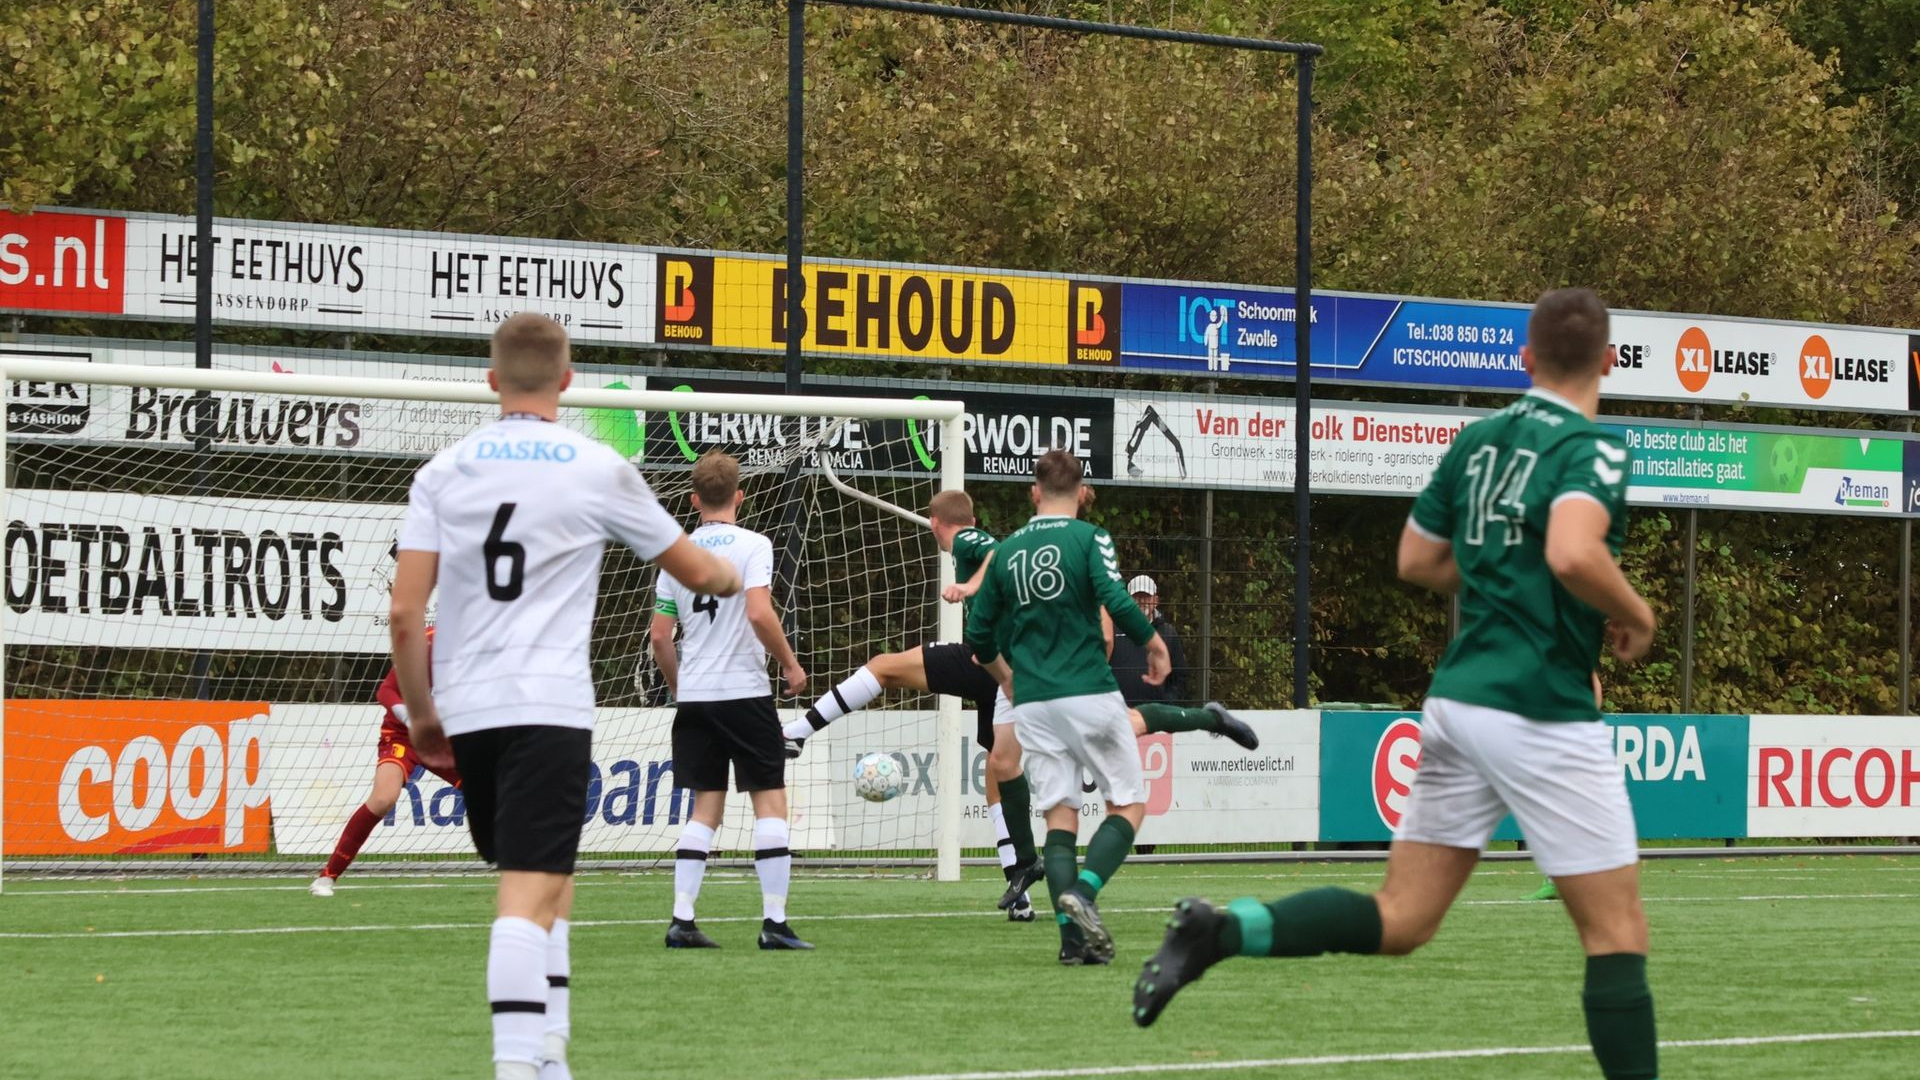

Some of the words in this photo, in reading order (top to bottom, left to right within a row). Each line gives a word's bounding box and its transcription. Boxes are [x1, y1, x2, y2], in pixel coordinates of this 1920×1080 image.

[232, 238, 364, 293] EETHUYS
[431, 251, 488, 299] HET
[499, 255, 624, 309] EETHUYS
[215, 293, 309, 312] ASSENDORP
[771, 267, 1016, 355] BEHOUD
[1238, 300, 1318, 324] Schoonmk
[483, 308, 572, 327] ASSRP
[1178, 295, 1236, 346] ICT
[664, 324, 703, 339] BEHOUD
[1237, 327, 1278, 348] Zwolle
[1457, 326, 1478, 343] 850
[1482, 327, 1496, 344] 63
[1499, 328, 1514, 345] 24
[1077, 348, 1112, 362] BEHOUD
[1393, 347, 1527, 372] ICTSCHOONMAAK.NL
[1680, 347, 1709, 373] XL
[1713, 350, 1769, 376] LEASE
[1803, 355, 1830, 380] XL
[1834, 357, 1889, 383] LEASE
[22, 412, 81, 426] FASHION
[1196, 409, 1239, 436] Van
[1248, 412, 1285, 438] der
[1311, 415, 1343, 441] olk
[927, 412, 1092, 457] RWOLDE
[1626, 429, 1641, 449] De
[1644, 430, 1677, 450] beste
[1680, 431, 1706, 452] club
[1708, 433, 1726, 453] als
[1729, 434, 1748, 454] het
[475, 436, 578, 464] DASKO
[1211, 442, 1265, 460] Grondwerk
[1275, 446, 1326, 461] straerk
[1384, 451, 1434, 467] agrarische
[1263, 469, 1424, 489] www.verkolkdienstverlening.nl
[1647, 456, 1714, 478] installaties
[1716, 463, 1746, 484] gaat.
[1465, 445, 1538, 546] 14
[1840, 479, 1889, 499] Breman
[483, 502, 526, 602] 6
[1007, 544, 1065, 606] 18
[1191, 756, 1295, 772] www.nextlevelict.nl
[58, 713, 271, 848] coop
